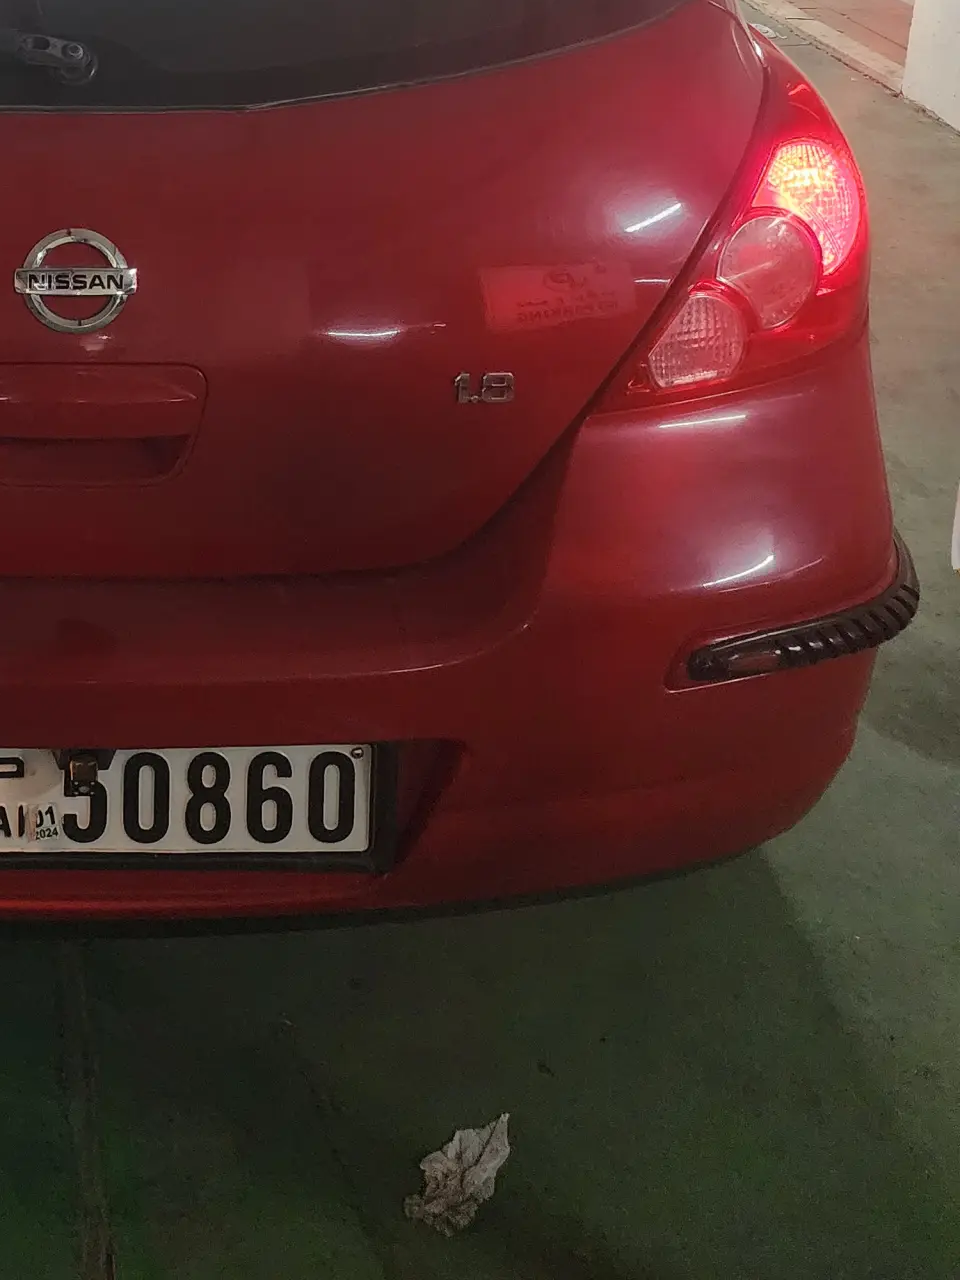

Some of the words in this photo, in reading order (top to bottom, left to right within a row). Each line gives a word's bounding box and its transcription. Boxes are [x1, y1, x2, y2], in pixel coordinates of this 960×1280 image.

[28, 273, 124, 291] NISSAN
[455, 372, 515, 404] 1.8
[62, 750, 356, 844] 50860
